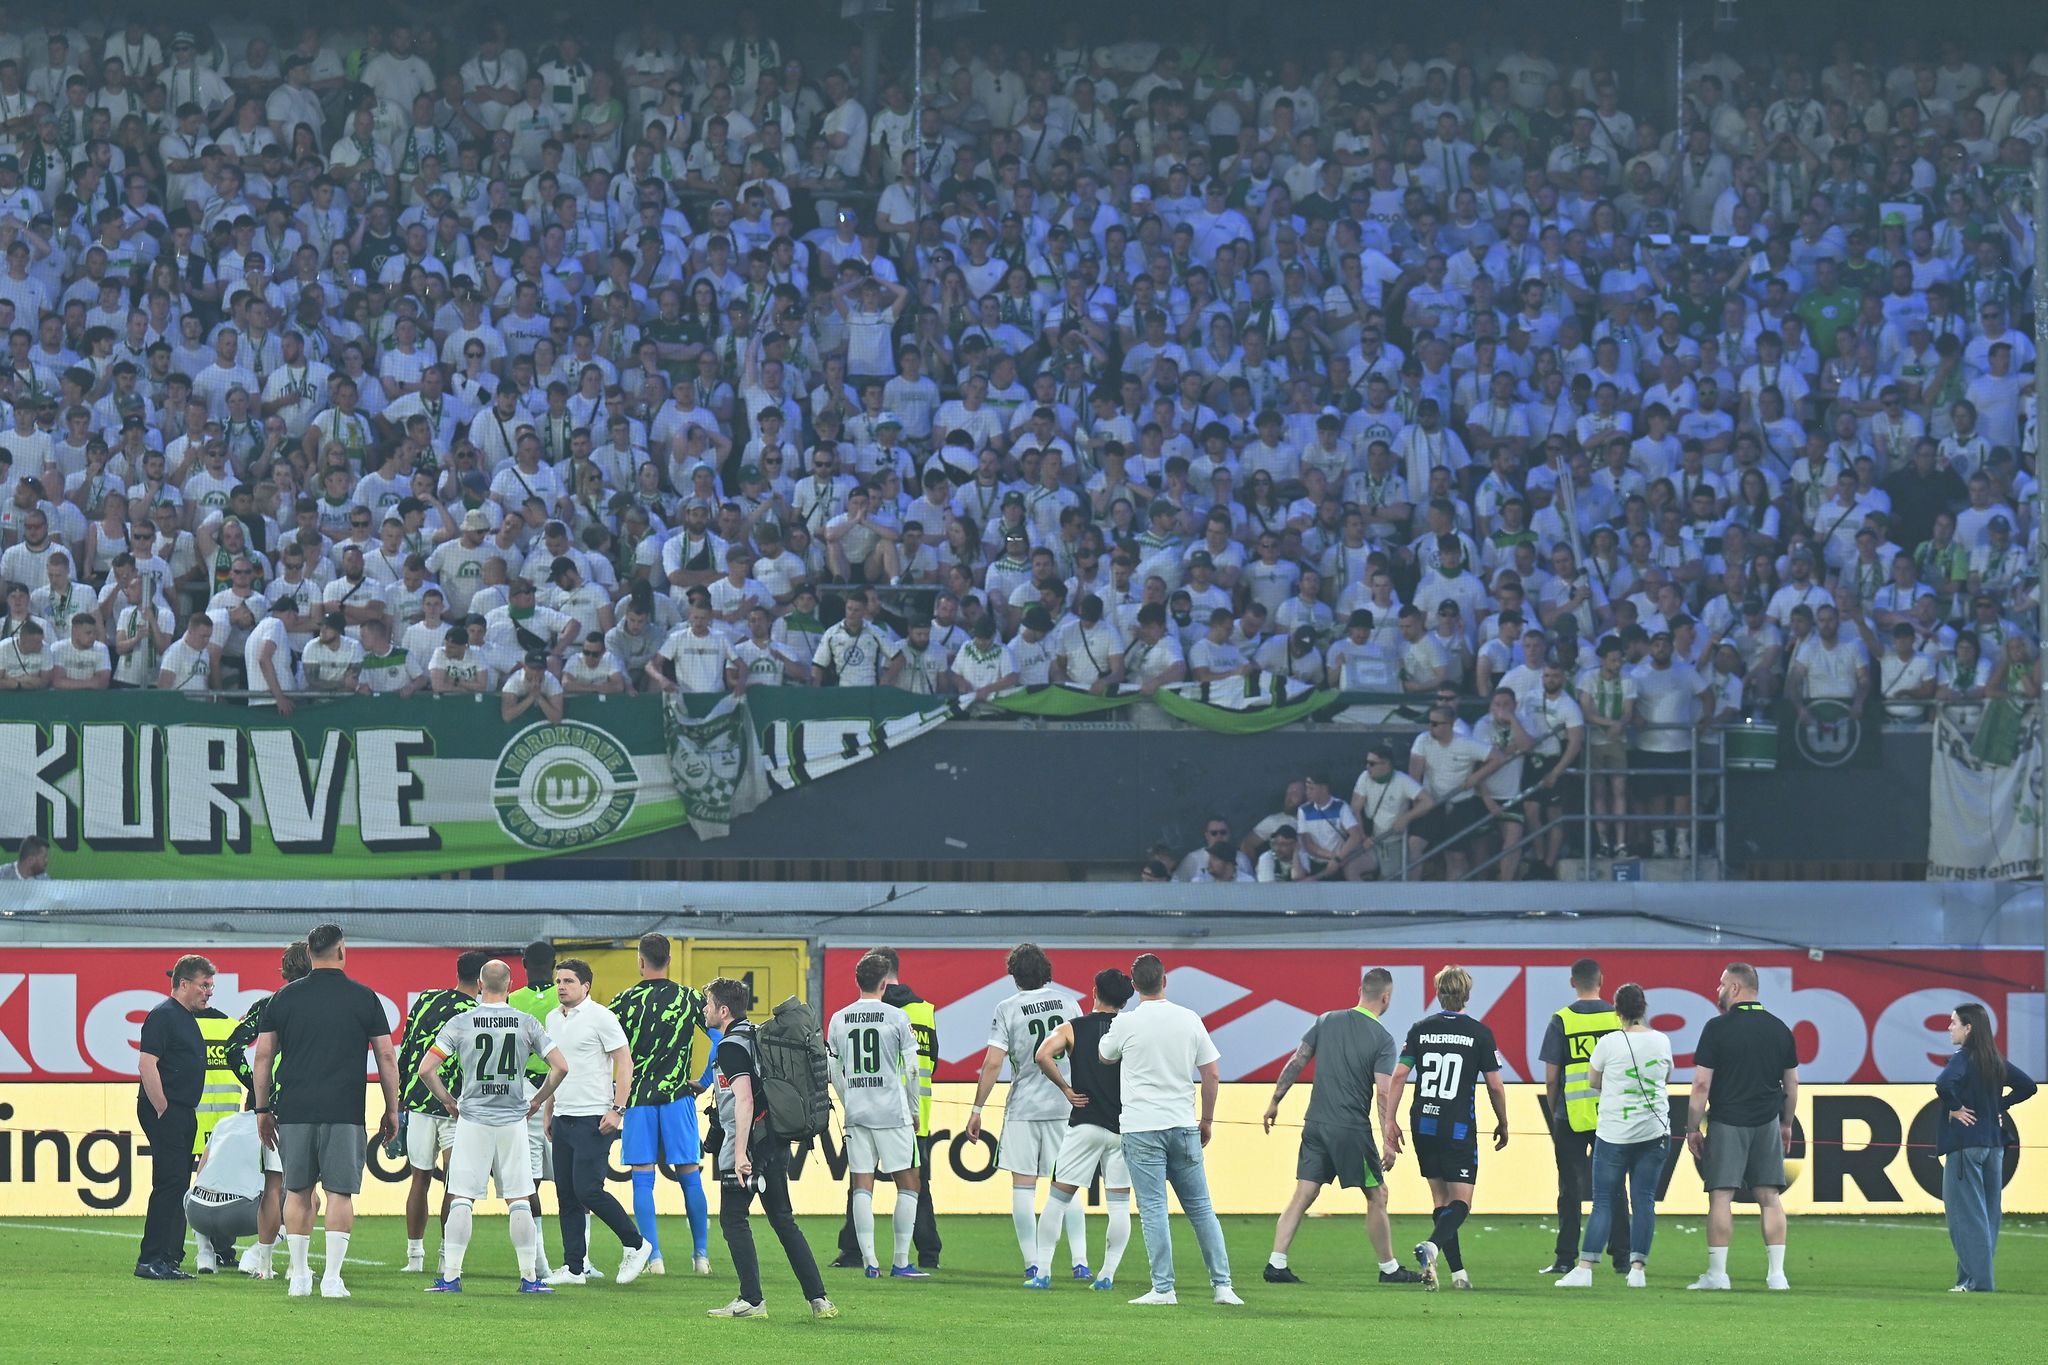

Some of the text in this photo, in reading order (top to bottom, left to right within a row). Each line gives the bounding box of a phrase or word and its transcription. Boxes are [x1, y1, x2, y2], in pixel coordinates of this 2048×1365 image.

[504, 726, 624, 774] NORDKURVE
[0, 722, 440, 853] KURVE
[507, 798, 629, 845] WOLFSBURG
[473, 1016, 519, 1028] WOLFSBURG
[844, 1012, 885, 1024] WOLFSBURG
[1020, 999, 1063, 1016] WOLFSBURG
[848, 1028, 881, 1074] 19
[1419, 1033, 1474, 1047] PADERBORN
[475, 1033, 518, 1081] 24
[481, 1083, 510, 1096] ERIKSEN
[1420, 1052, 1464, 1100] 20
[1422, 1102, 1441, 1115] GÖTZE
